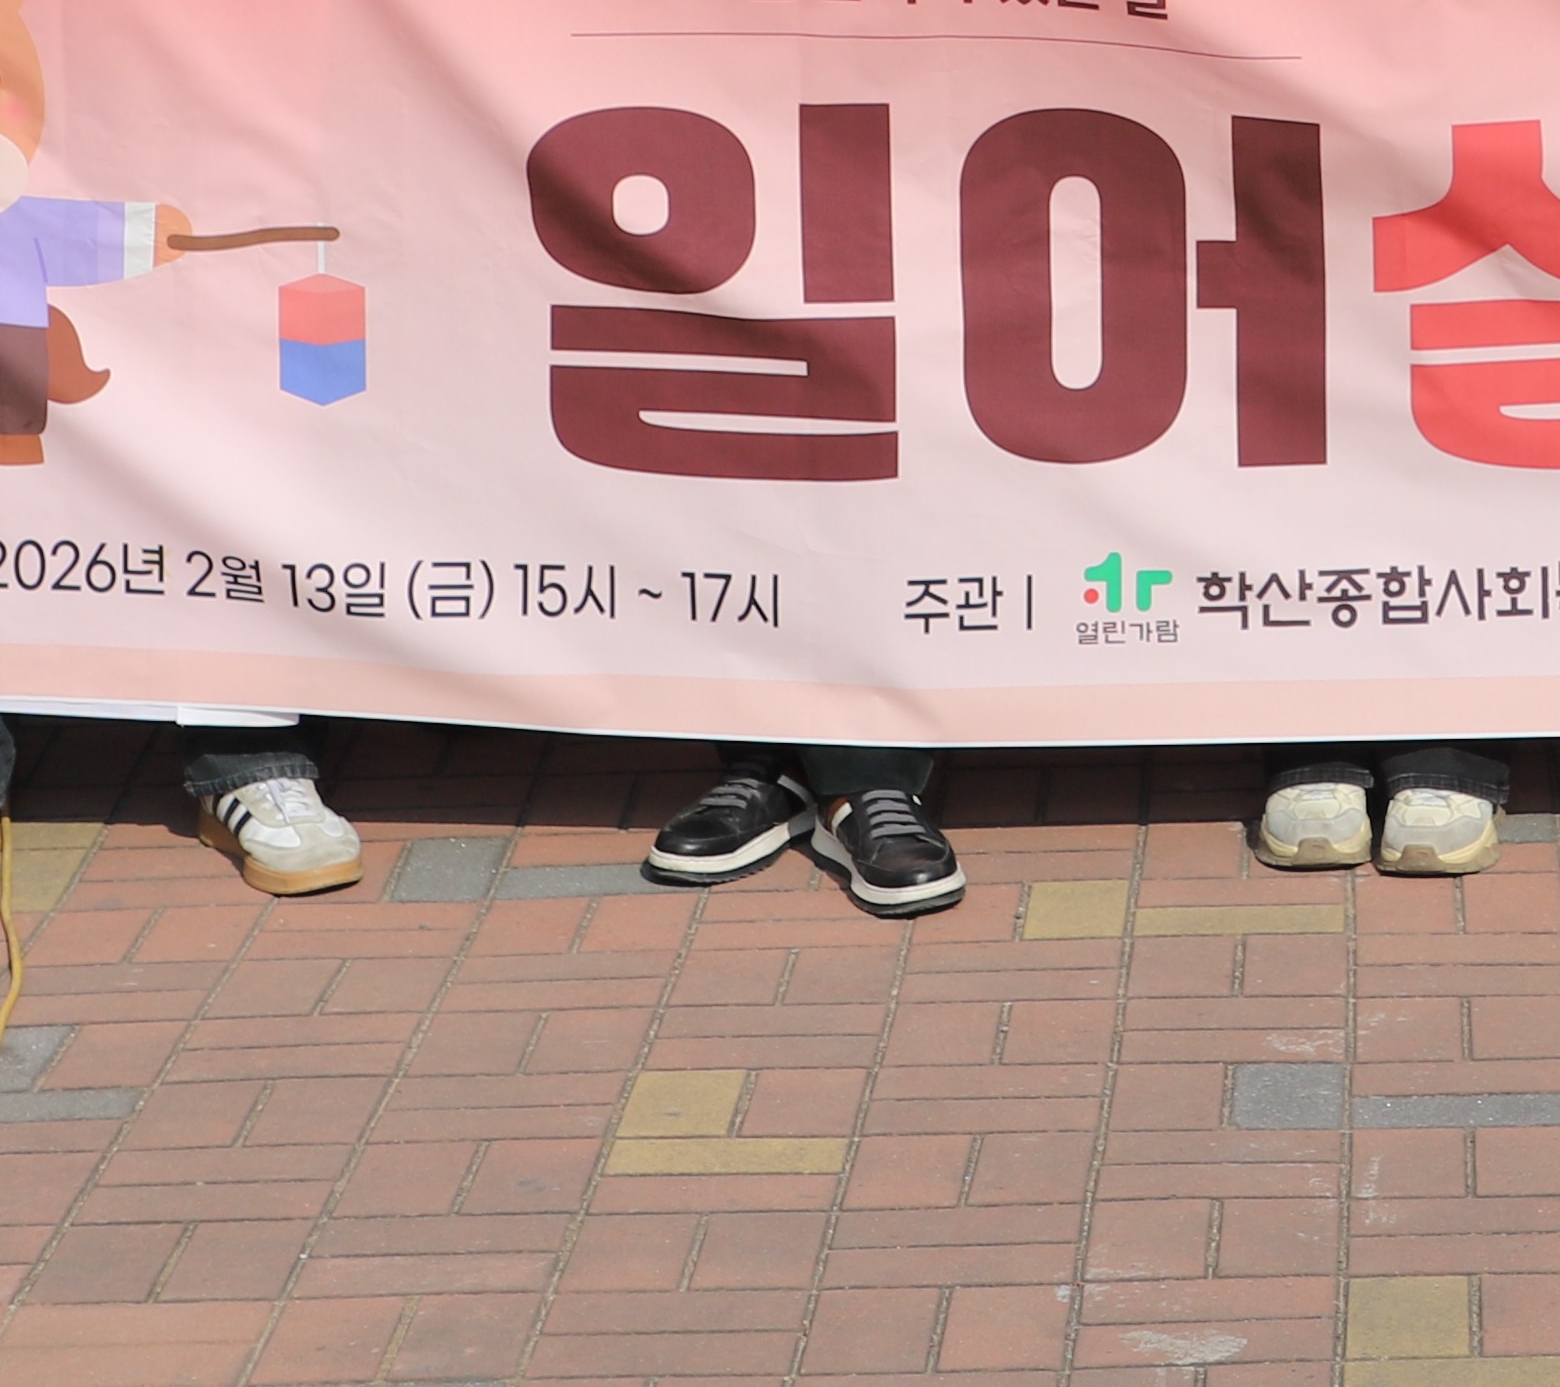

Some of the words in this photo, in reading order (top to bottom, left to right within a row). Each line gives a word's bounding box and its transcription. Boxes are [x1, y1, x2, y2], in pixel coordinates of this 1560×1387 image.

[183, 549, 267, 606] 2월
[281, 557, 387, 620] 13일
[406, 556, 497, 622] (금)
[511, 559, 618, 621] 15시
[680, 568, 782, 628] 17시
[903, 574, 1004, 634] 주관
[1074, 618, 1181, 646] 열린가람
